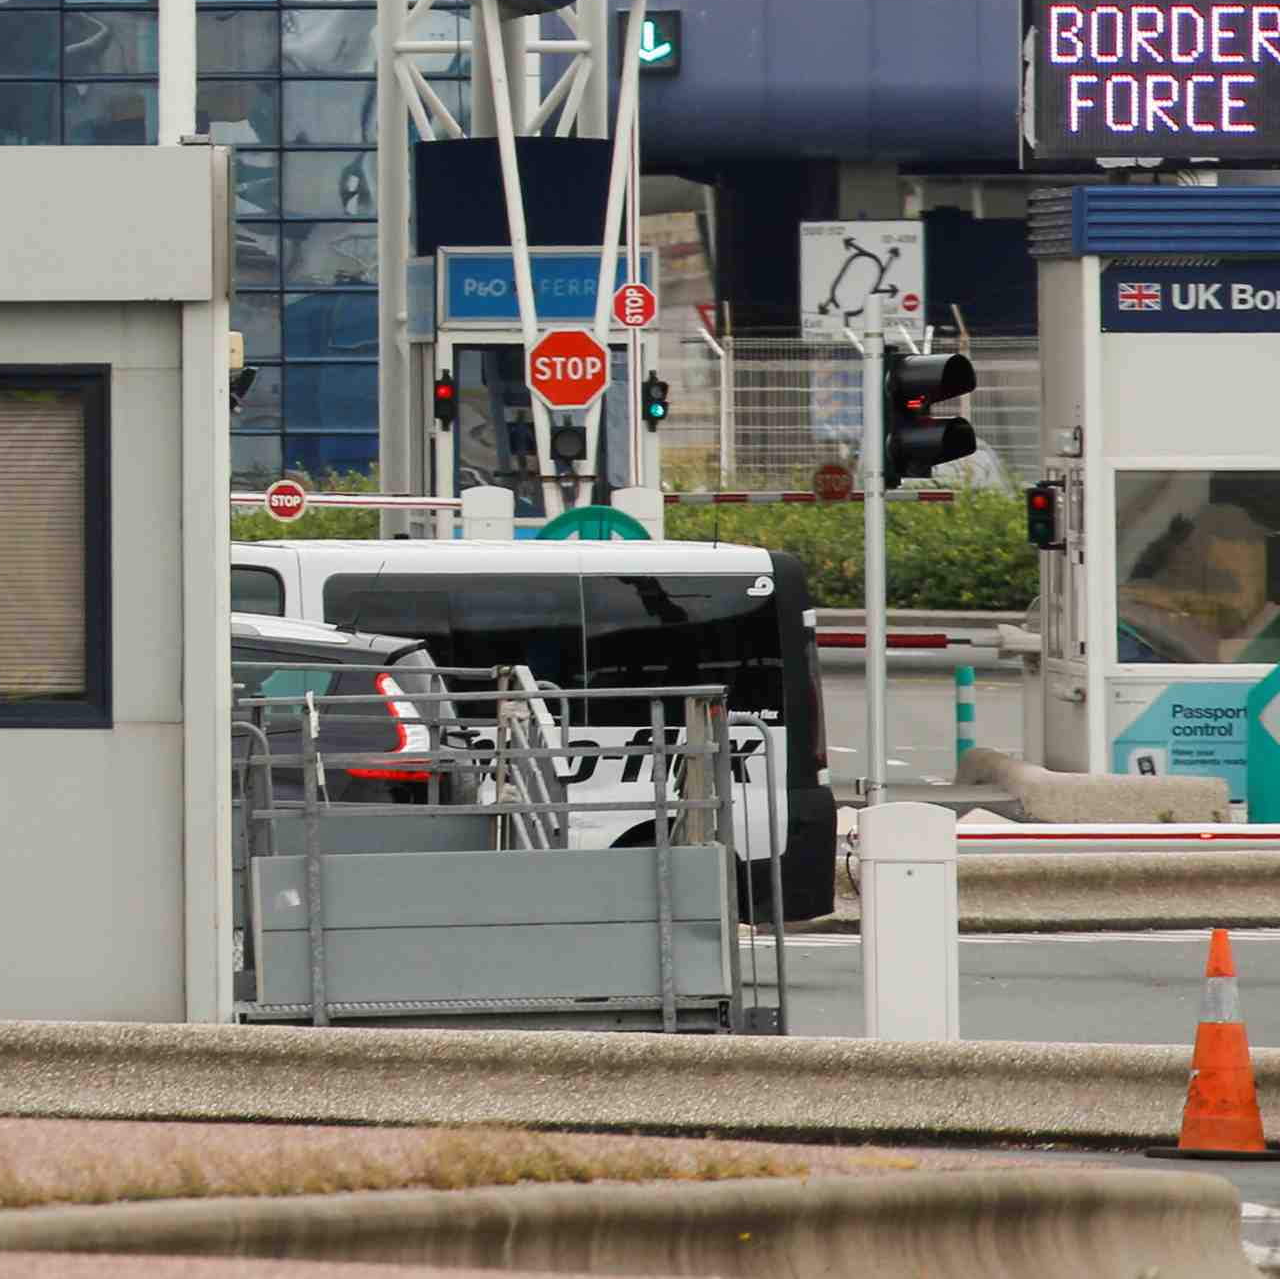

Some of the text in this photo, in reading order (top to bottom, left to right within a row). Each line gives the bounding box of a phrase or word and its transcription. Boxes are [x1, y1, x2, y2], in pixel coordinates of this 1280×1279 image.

[1048, 5, 1280, 63] BORDER
[1067, 74, 1256, 133] FORCE
[464, 278, 596, 298] P&O FERR
[1171, 283, 1280, 310] UK Bo
[625, 288, 645, 324] STOP
[535, 356, 602, 381] STOP
[271, 495, 301, 508] STOP
[1171, 723, 1233, 737] control
